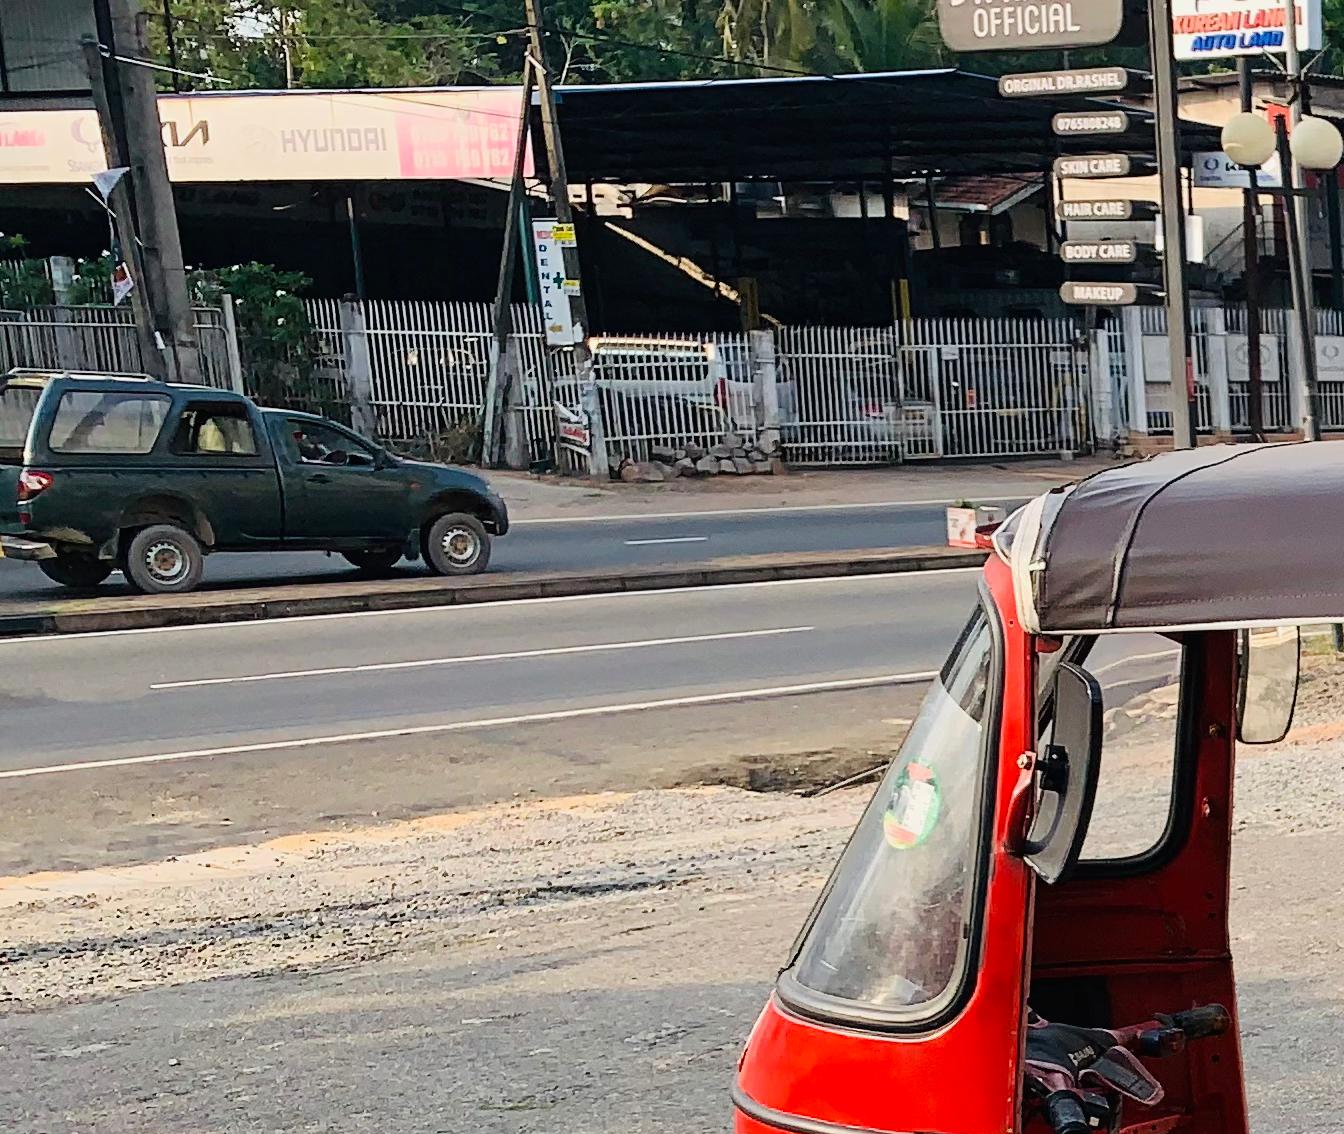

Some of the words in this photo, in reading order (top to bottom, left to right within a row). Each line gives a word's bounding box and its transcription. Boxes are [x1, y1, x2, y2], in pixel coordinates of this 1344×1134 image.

[973, 3, 1081, 38] OFFICIAL
[1173, 11, 1242, 34] KOREAN
[1192, 34, 1237, 51] AUTO
[1239, 31, 1284, 48] LAND
[1004, 77, 1056, 93] ORGINAL
[1056, 72, 1121, 90] DR.RASHEL
[281, 127, 388, 153] HYUNDAI
[1061, 160, 1089, 174] SKIN
[1090, 158, 1122, 173] CARE
[1063, 203, 1092, 216] HAIR
[1093, 202, 1125, 215] CARE
[1065, 245, 1097, 258] BODY
[1098, 244, 1131, 258] CARE
[538, 244, 553, 320] DENTAL
[1072, 286, 1123, 301] MAKEUP
